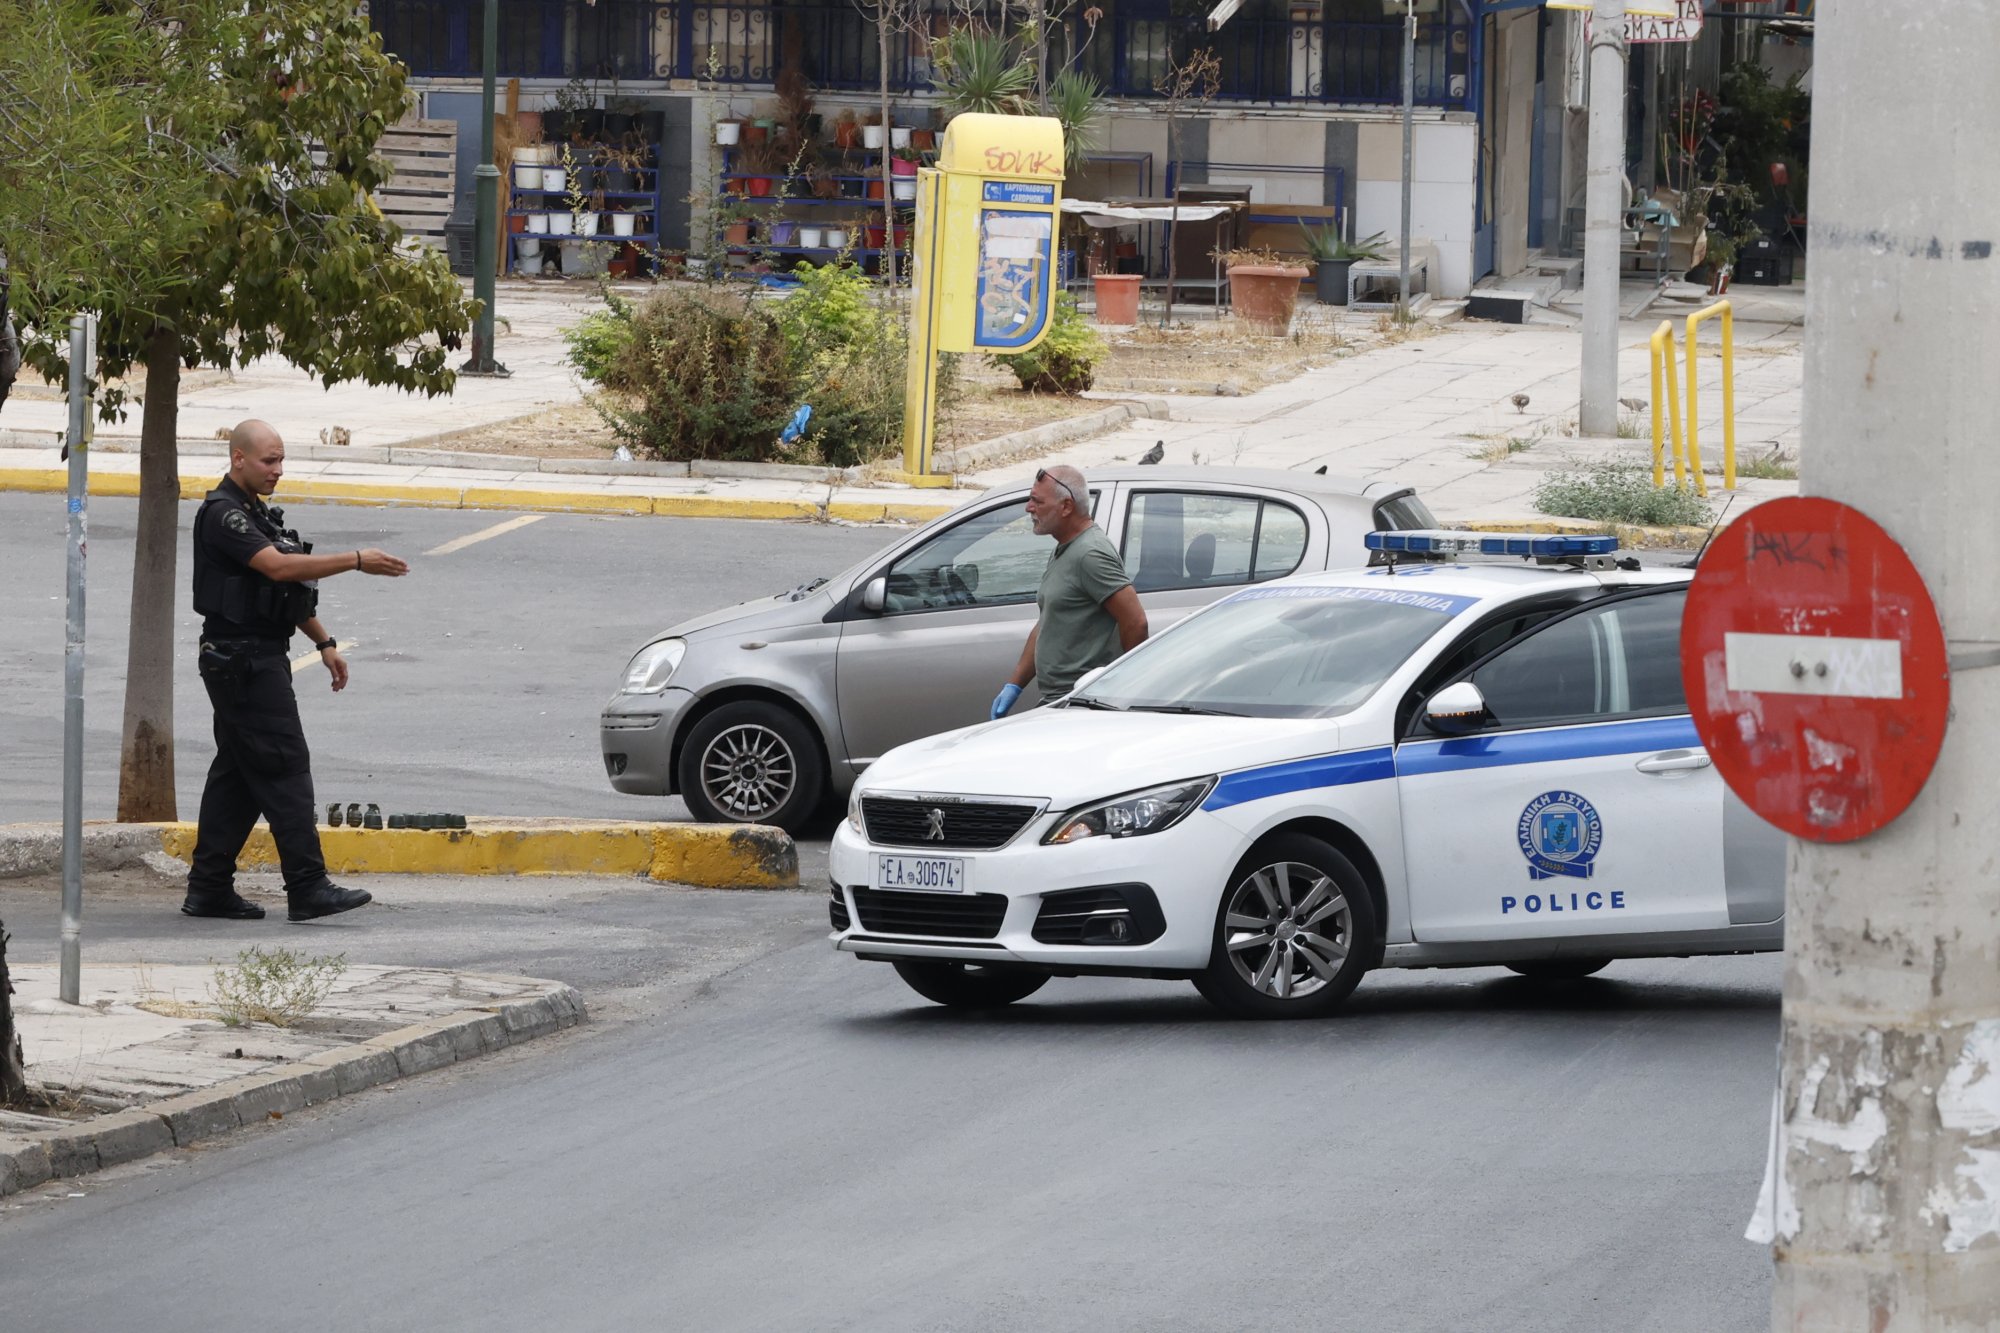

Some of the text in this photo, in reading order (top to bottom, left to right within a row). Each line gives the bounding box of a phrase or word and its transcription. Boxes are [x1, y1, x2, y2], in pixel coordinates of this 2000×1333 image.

[1011, 193, 1045, 204] CARDPHONE
[1335, 588, 1454, 611] ΑΣΤΥΝΟΜΙΑ
[1519, 792, 1600, 859] ΕΛΛΗΝΙΚΗ ΑΣΤΥΝΟΜΙΑ
[916, 860, 954, 887] 30674
[1501, 891, 1625, 914] POLICE
